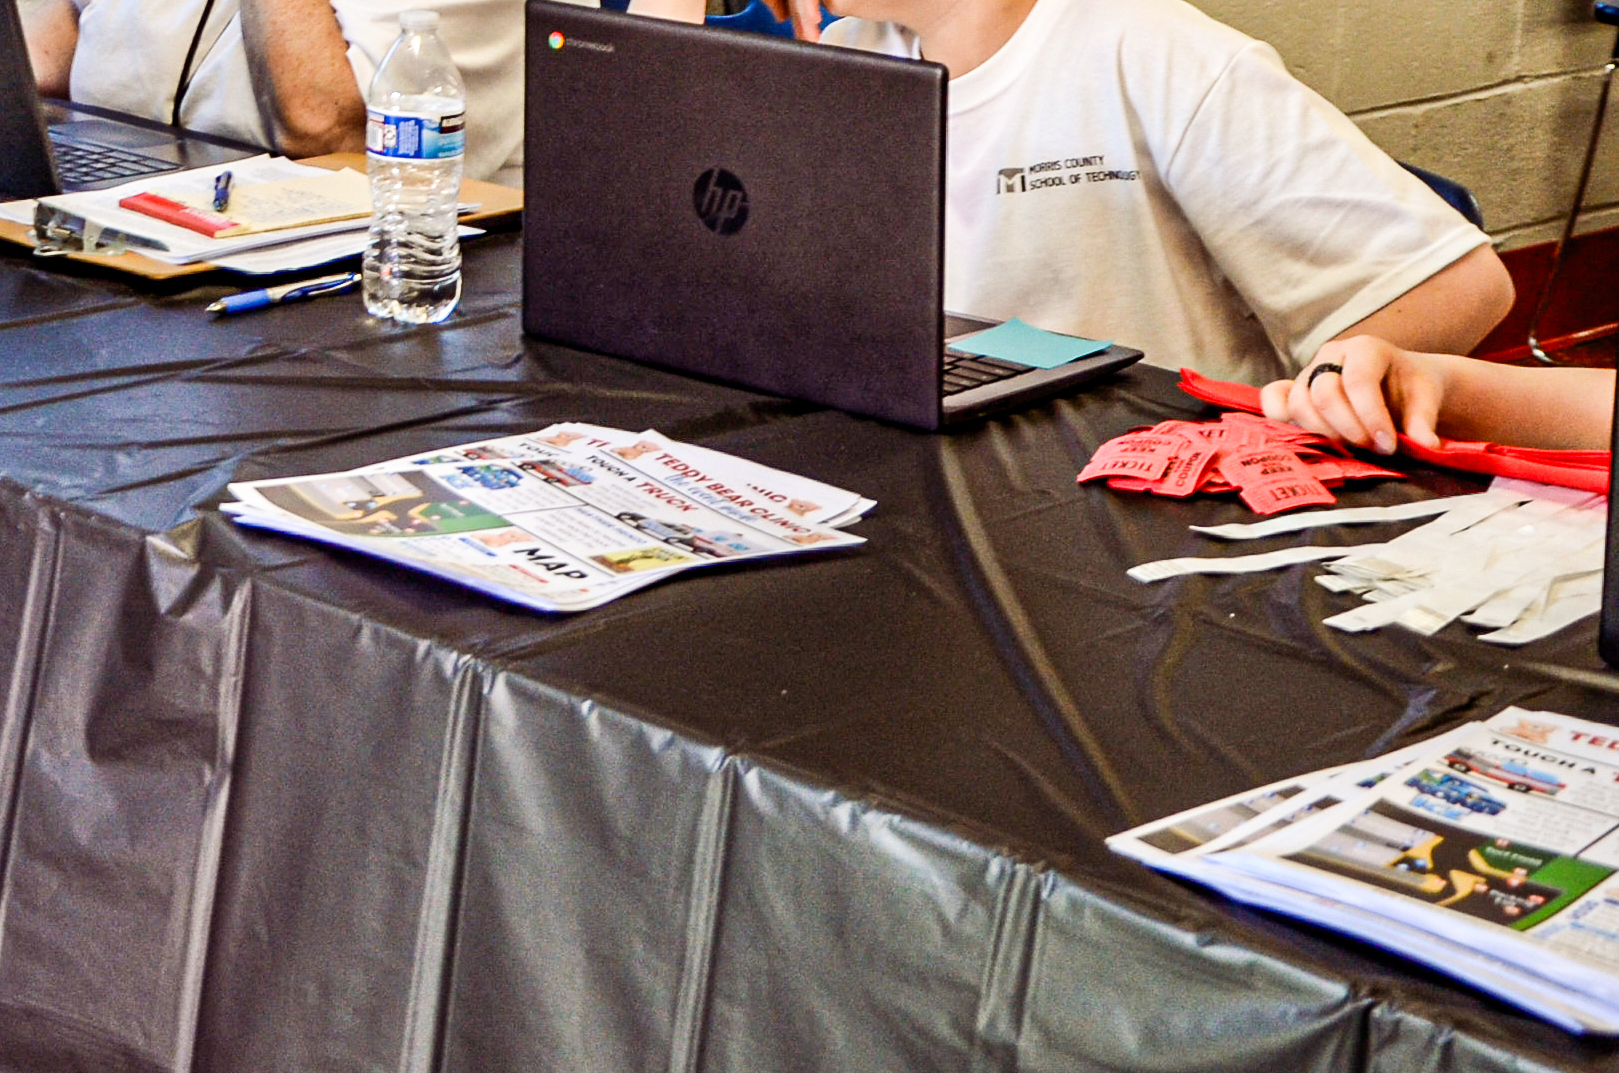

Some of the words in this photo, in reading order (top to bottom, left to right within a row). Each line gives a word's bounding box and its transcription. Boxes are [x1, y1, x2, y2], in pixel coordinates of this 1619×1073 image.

[1029, 160, 1062, 174] MORRIS
[1064, 155, 1105, 169] COUNTY
[1030, 176, 1066, 190] SCHOOL
[1069, 173, 1082, 185] OF
[693, 168, 749, 235] hp
[1101, 461, 1153, 472] TICKET
[1175, 451, 1202, 487] COUPON
[1240, 453, 1293, 468] COUPON
[635, 481, 699, 512] TRUCK
[655, 452, 713, 483] TEDDY
[705, 482, 754, 508] BEAR
[750, 506, 811, 534] CLINIC
[1269, 484, 1323, 501] TICKET
[512, 547, 589, 579] MAP
[1491, 737, 1577, 769] TOUCH
[1580, 766, 1597, 776] A
